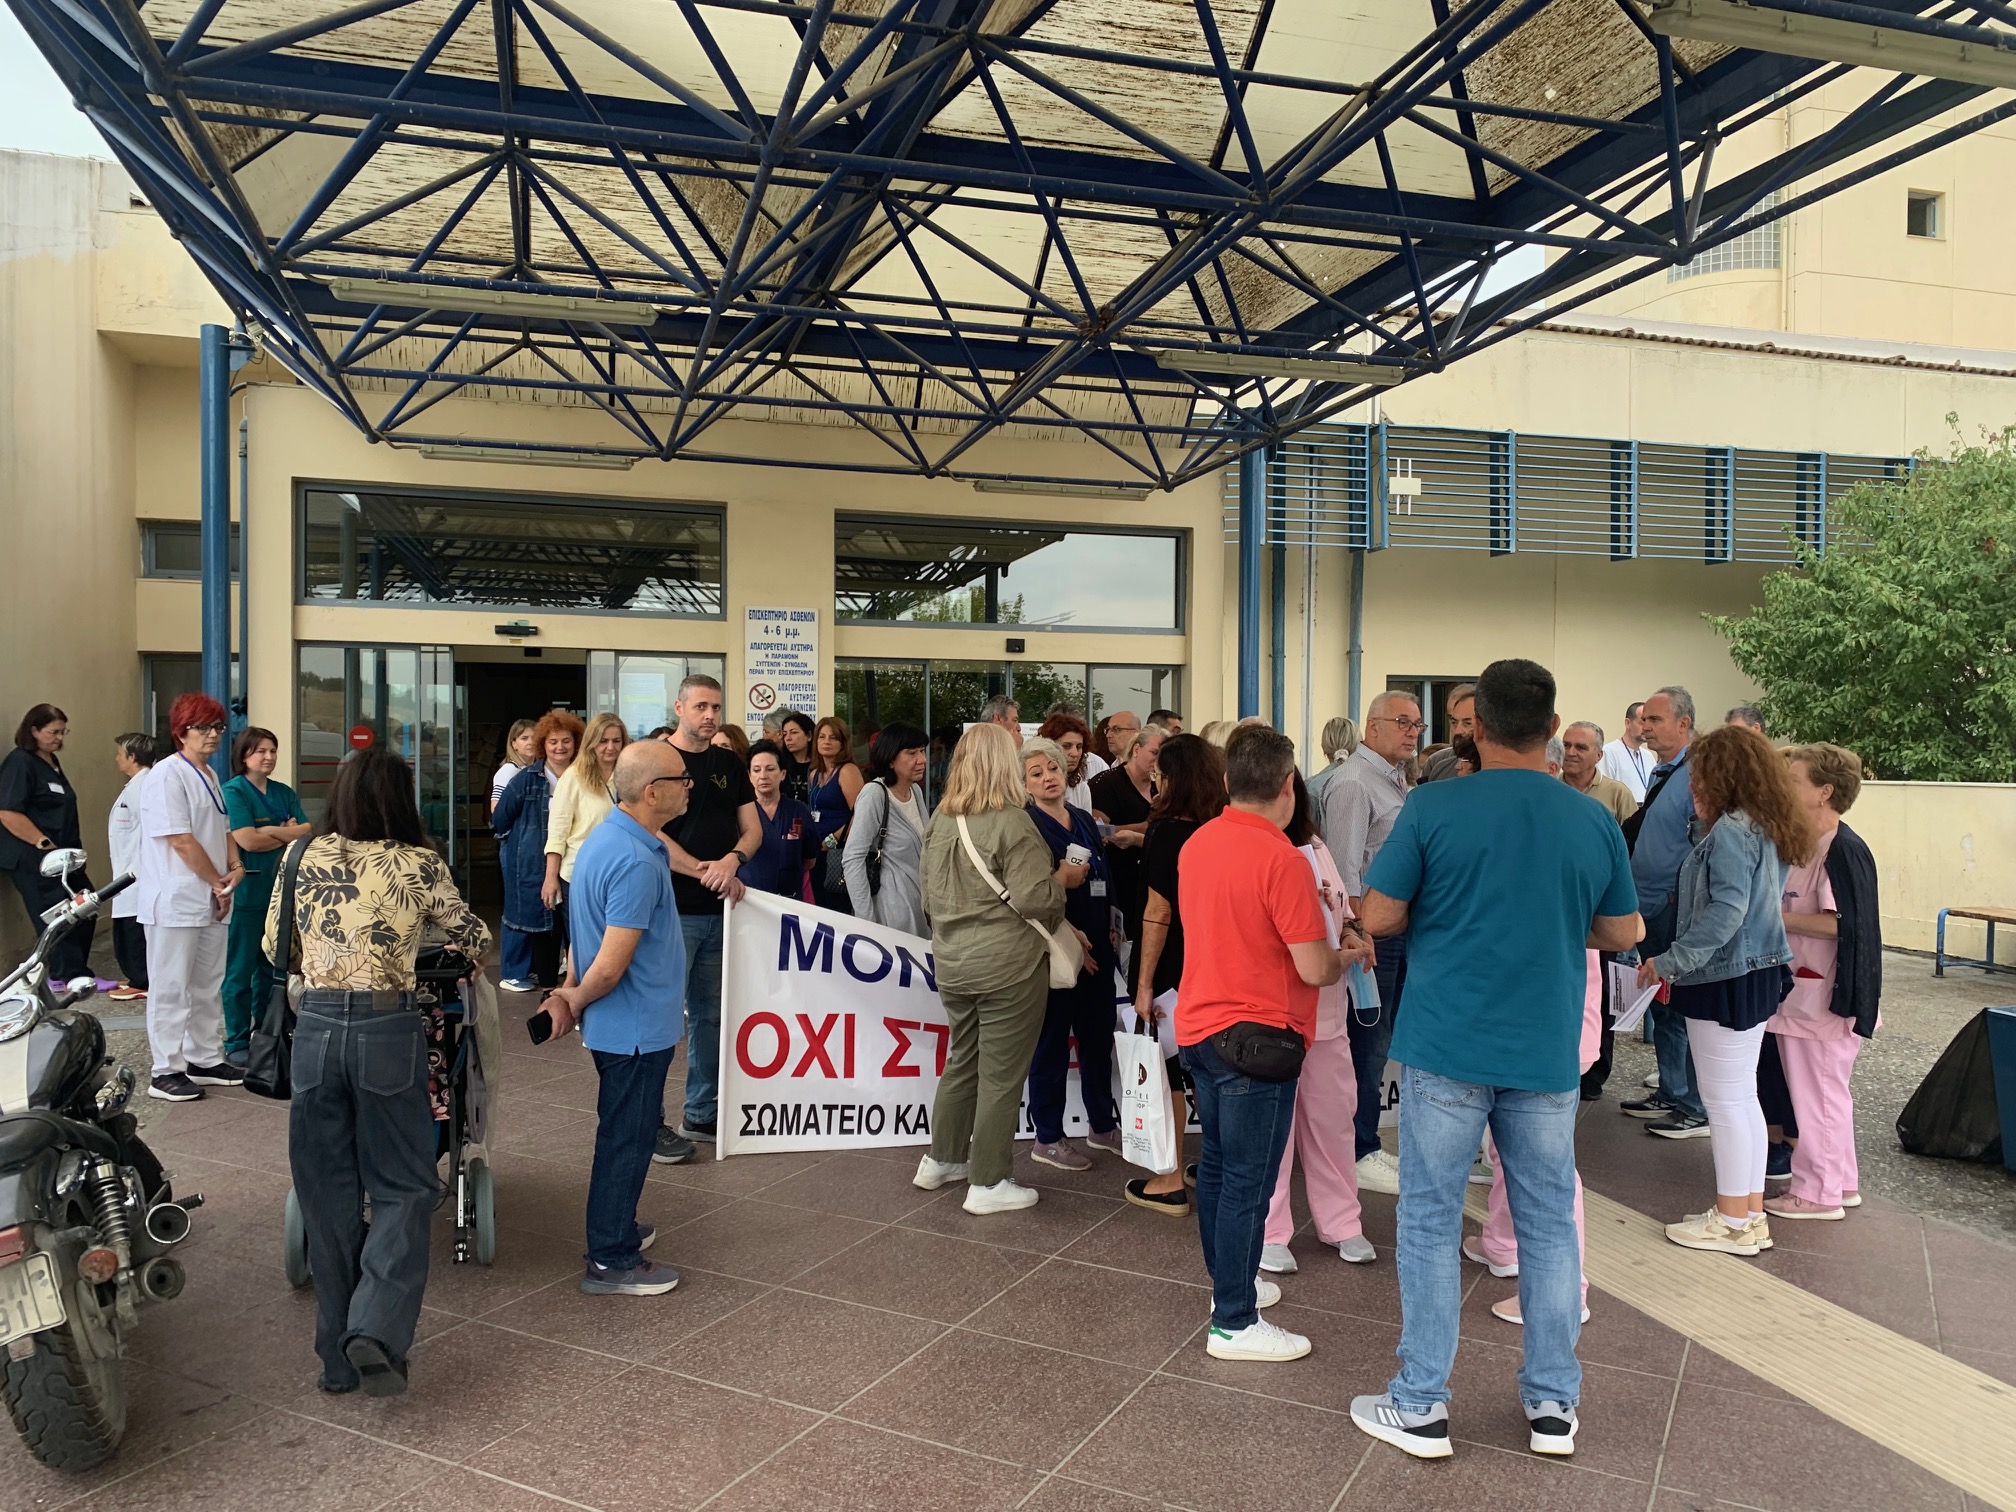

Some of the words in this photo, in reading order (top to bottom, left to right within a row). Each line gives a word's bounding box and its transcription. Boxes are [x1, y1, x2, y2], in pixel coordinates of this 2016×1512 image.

[749, 610, 787, 621] ΕΠΙΣΚΕΠΤΗΡΙΟ
[790, 611, 815, 622] ΑΣΘΕΝΩΝ
[764, 625, 769, 635] 4
[776, 625, 781, 635] 6
[785, 627, 800, 638] μ.μ.
[750, 642, 788, 651] ΑΠΑΓΟΡΕΥΕΤΑΙ
[790, 643, 814, 652] ΑΥΣΤΗΡΑ
[755, 660, 781, 668] ΣΥΓΓΕΝΩΝ
[778, 669, 815, 677] ΕΠΙΣΚΕΠΤΗΡΙΟΥ
[778, 683, 817, 692] ΑΠΑΓΟΡΕΥΕΤΑΙ
[789, 693, 817, 702] ΑΥΣΤΗΡΩΣ
[789, 703, 816, 712] ΚΑΠΝΙΣΜΑ
[747, 712, 764, 722] ΕΝΤΟΣ
[1071, 857, 1083, 866] OZ
[735, 1011, 856, 1079] ΟΧΙ
[739, 1103, 886, 1137] ΣΩΜΑΤΕΙΟ
